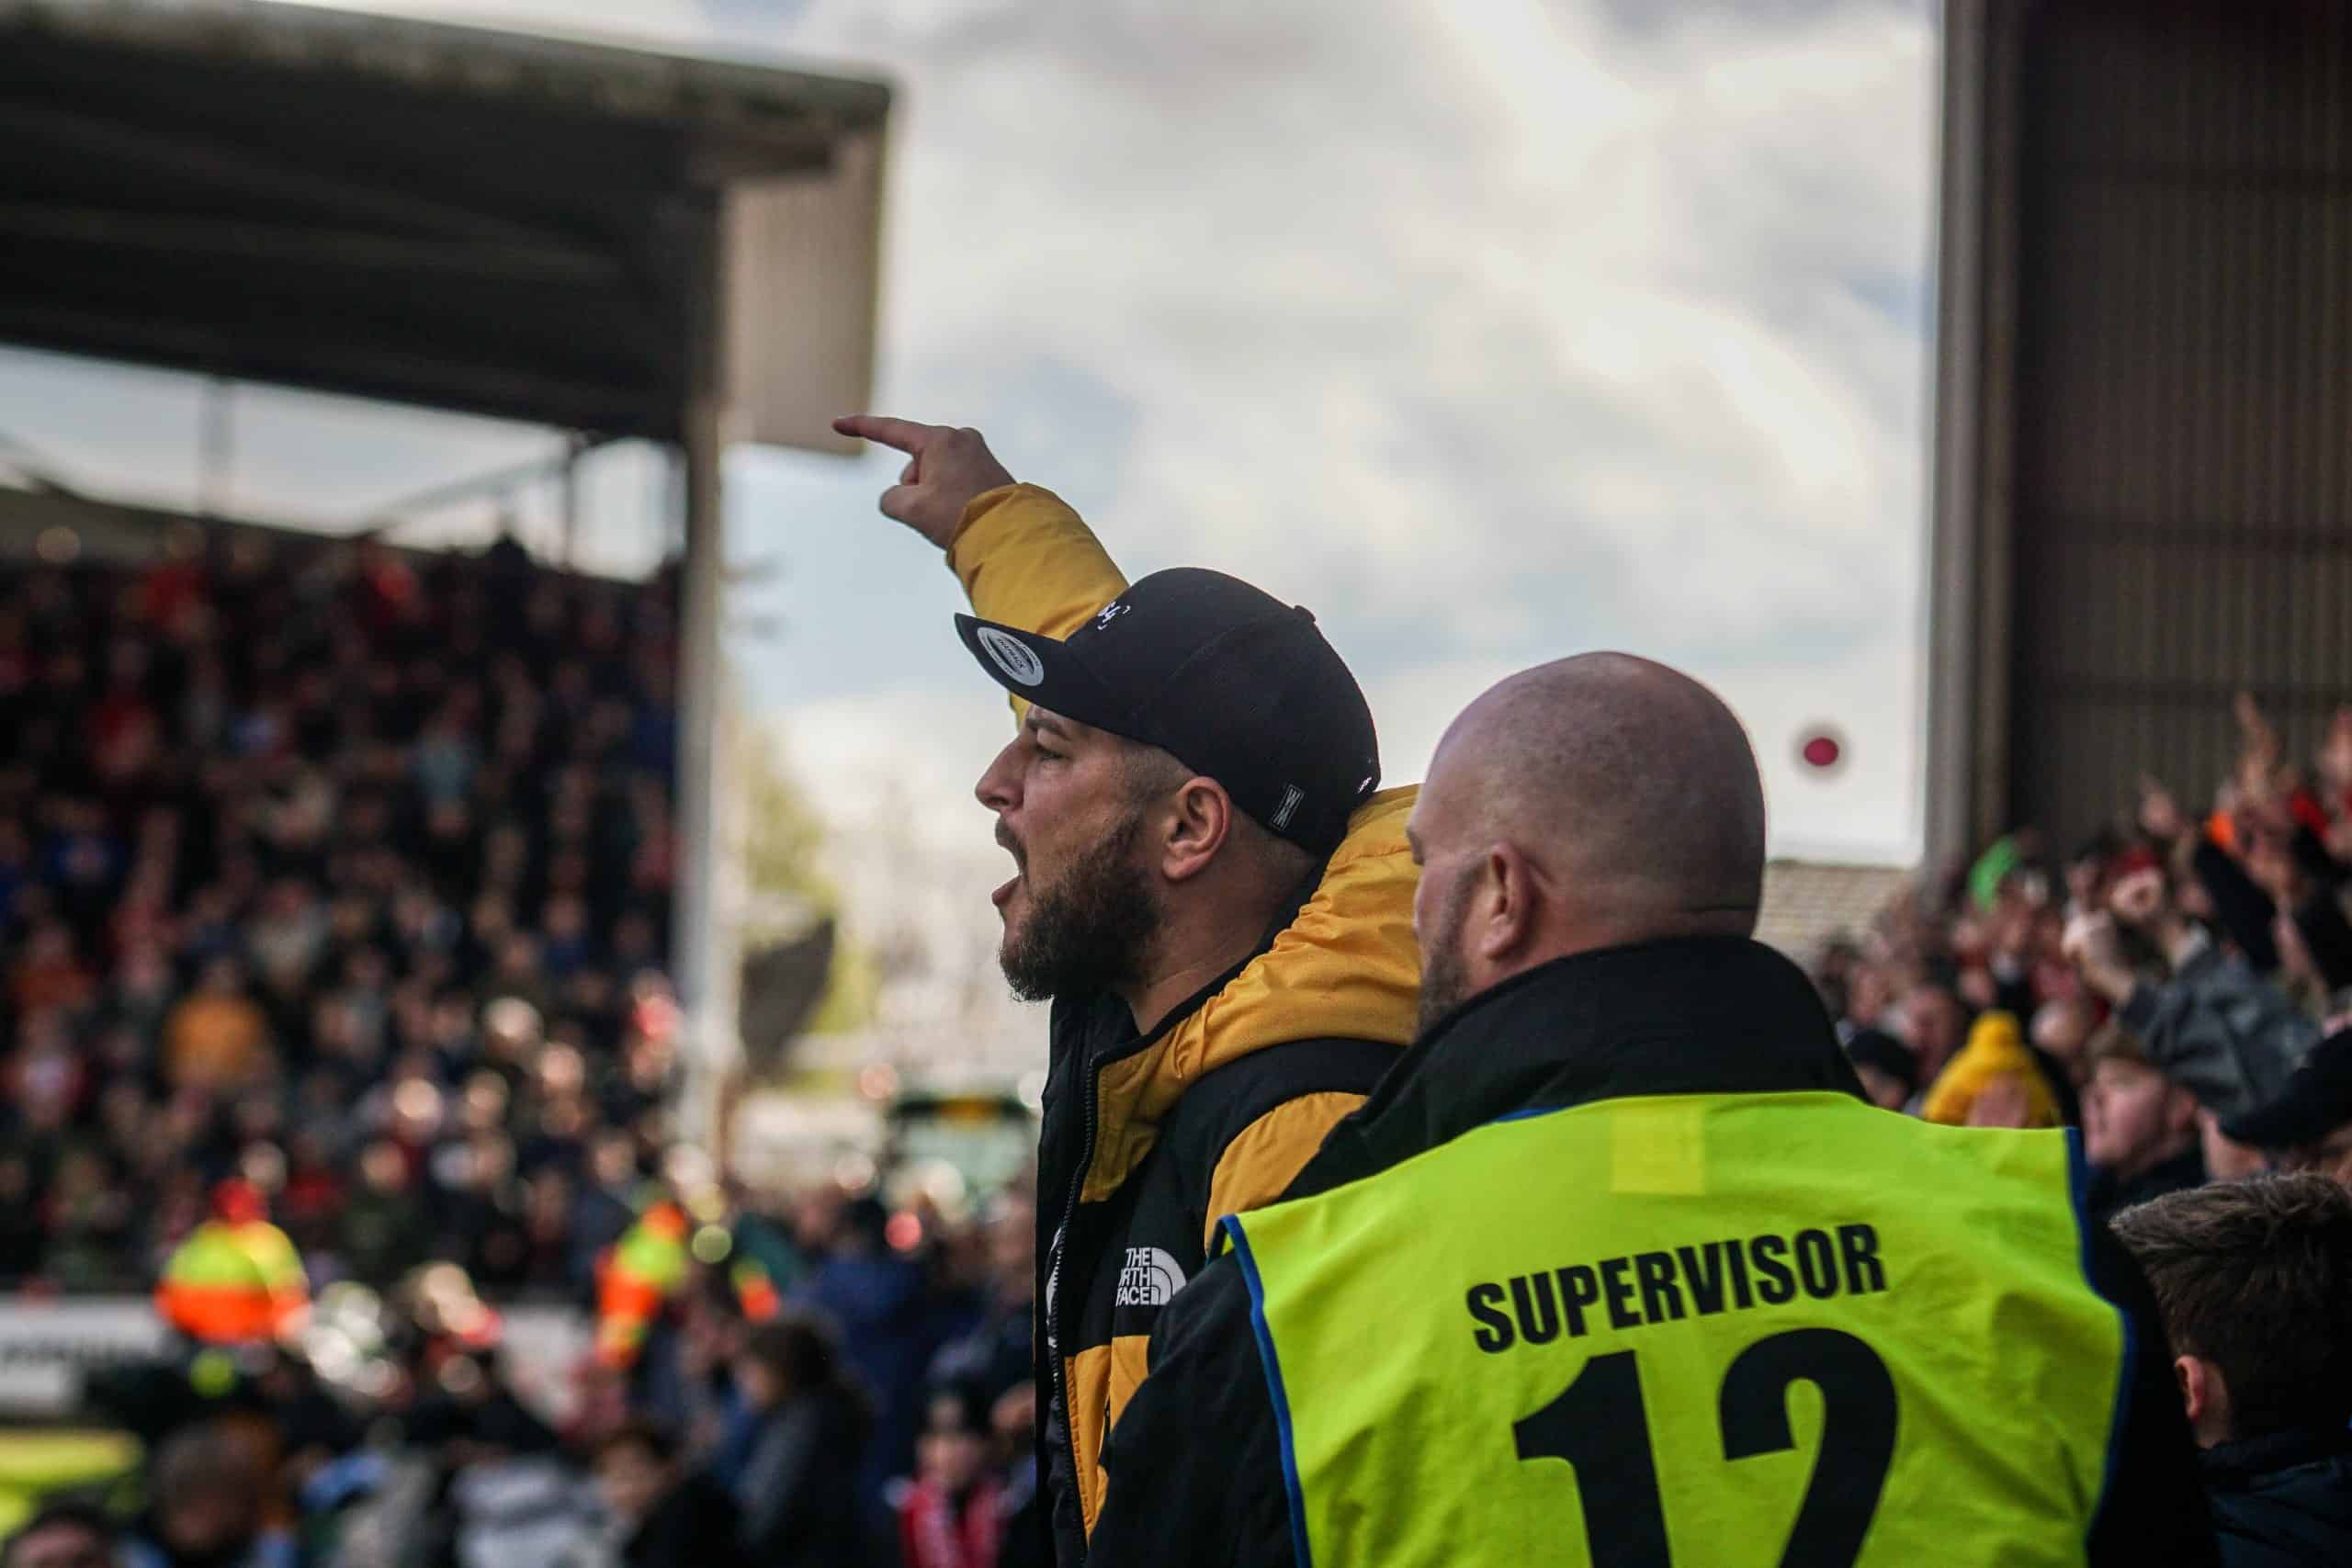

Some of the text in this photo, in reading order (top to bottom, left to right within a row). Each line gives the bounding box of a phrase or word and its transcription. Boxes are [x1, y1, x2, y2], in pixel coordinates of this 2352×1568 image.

[1118, 1267, 1150, 1287] RTH
[1125, 1247, 1150, 1267] THE
[1466, 1223, 1888, 1353] SUPERVISOR
[1512, 1326, 1900, 1568] 12
